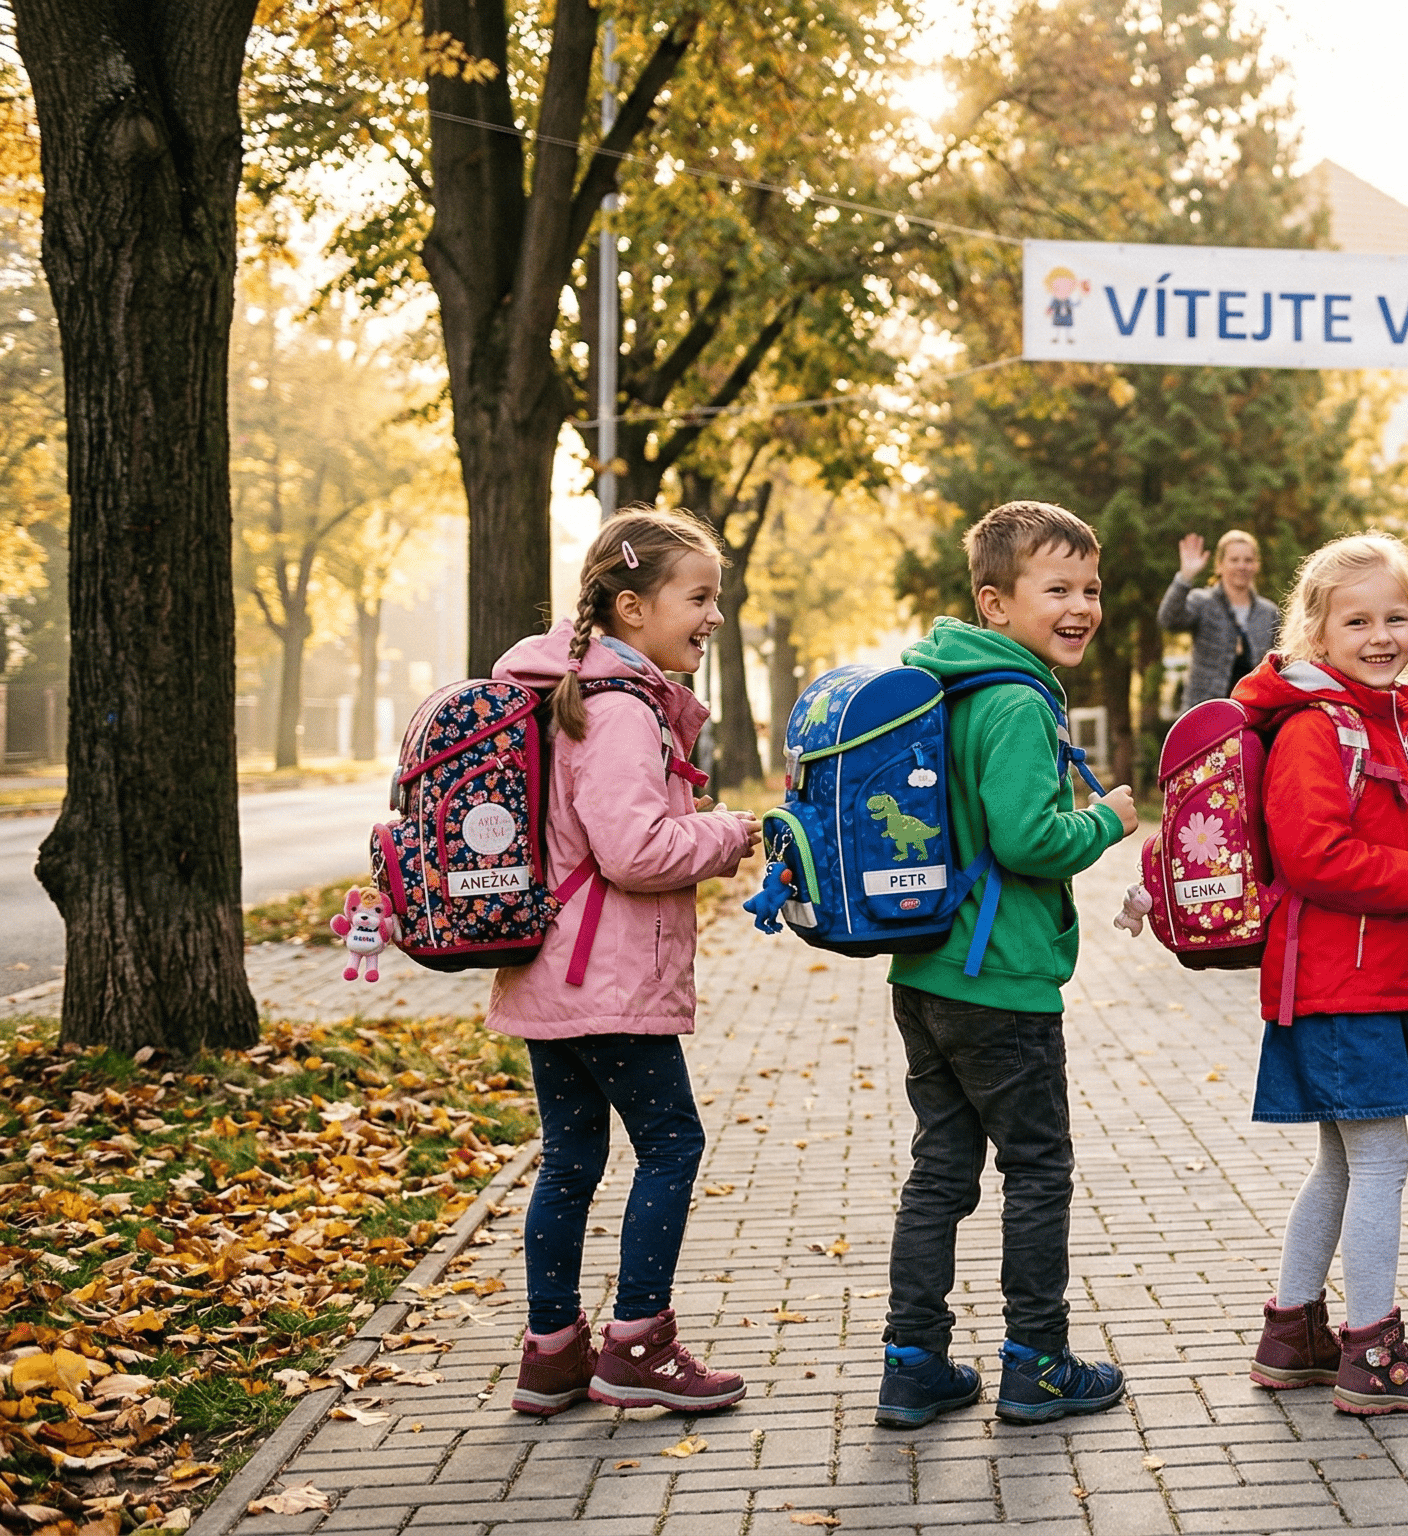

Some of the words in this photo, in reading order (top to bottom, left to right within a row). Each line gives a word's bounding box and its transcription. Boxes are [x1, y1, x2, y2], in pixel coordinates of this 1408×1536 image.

[1103, 271, 1353, 342] VÍTEJTE
[460, 871, 520, 890] ANEŽKA
[890, 873, 927, 888] PETR
[1183, 882, 1226, 899] LENKA
